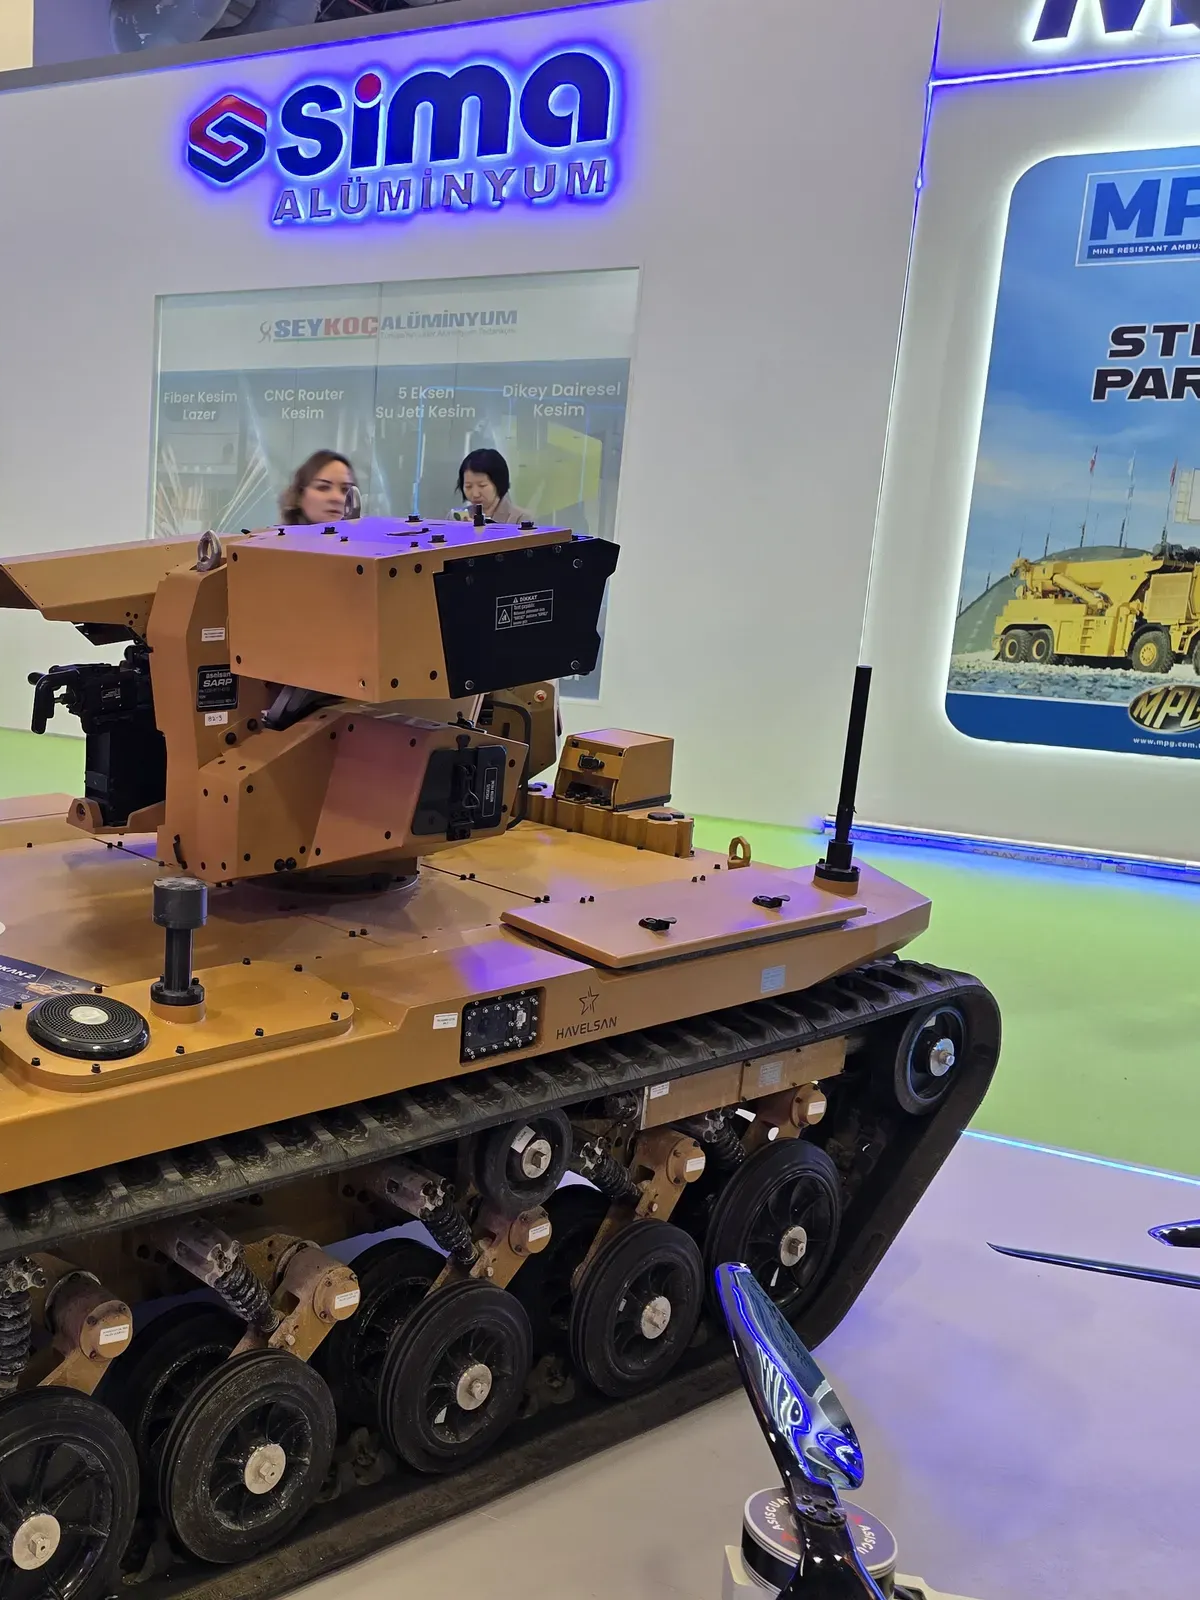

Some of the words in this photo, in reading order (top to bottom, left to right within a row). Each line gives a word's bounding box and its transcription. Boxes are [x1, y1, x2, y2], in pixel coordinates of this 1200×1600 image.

[277, 51, 612, 177] sima
[273, 160, 606, 222] ALÜMİNYUM
[1092, 247, 1115, 255] MINE
[1117, 244, 1168, 254] RESISTANT
[274, 316, 378, 339] SEYKOÇ
[380, 309, 517, 331] ALÜMİNYUM
[163, 391, 195, 403] Fiber
[198, 390, 237, 403] Kesim
[264, 389, 295, 401] CNC
[299, 388, 344, 401] Router
[398, 387, 407, 399] 5
[411, 386, 455, 399] Eksen
[502, 384, 549, 401] Dikey
[552, 382, 620, 397] Dairesel
[182, 408, 216, 420] Lazer
[281, 407, 324, 419] Kesim
[375, 406, 394, 419] Su
[397, 404, 424, 419] Jeti
[428, 404, 475, 418] Kesim
[533, 403, 584, 417] Kesim
[203, 678, 233, 688] SARP
[26, 972, 37, 980] 2
[556, 1016, 618, 1040] HAVELSAN
